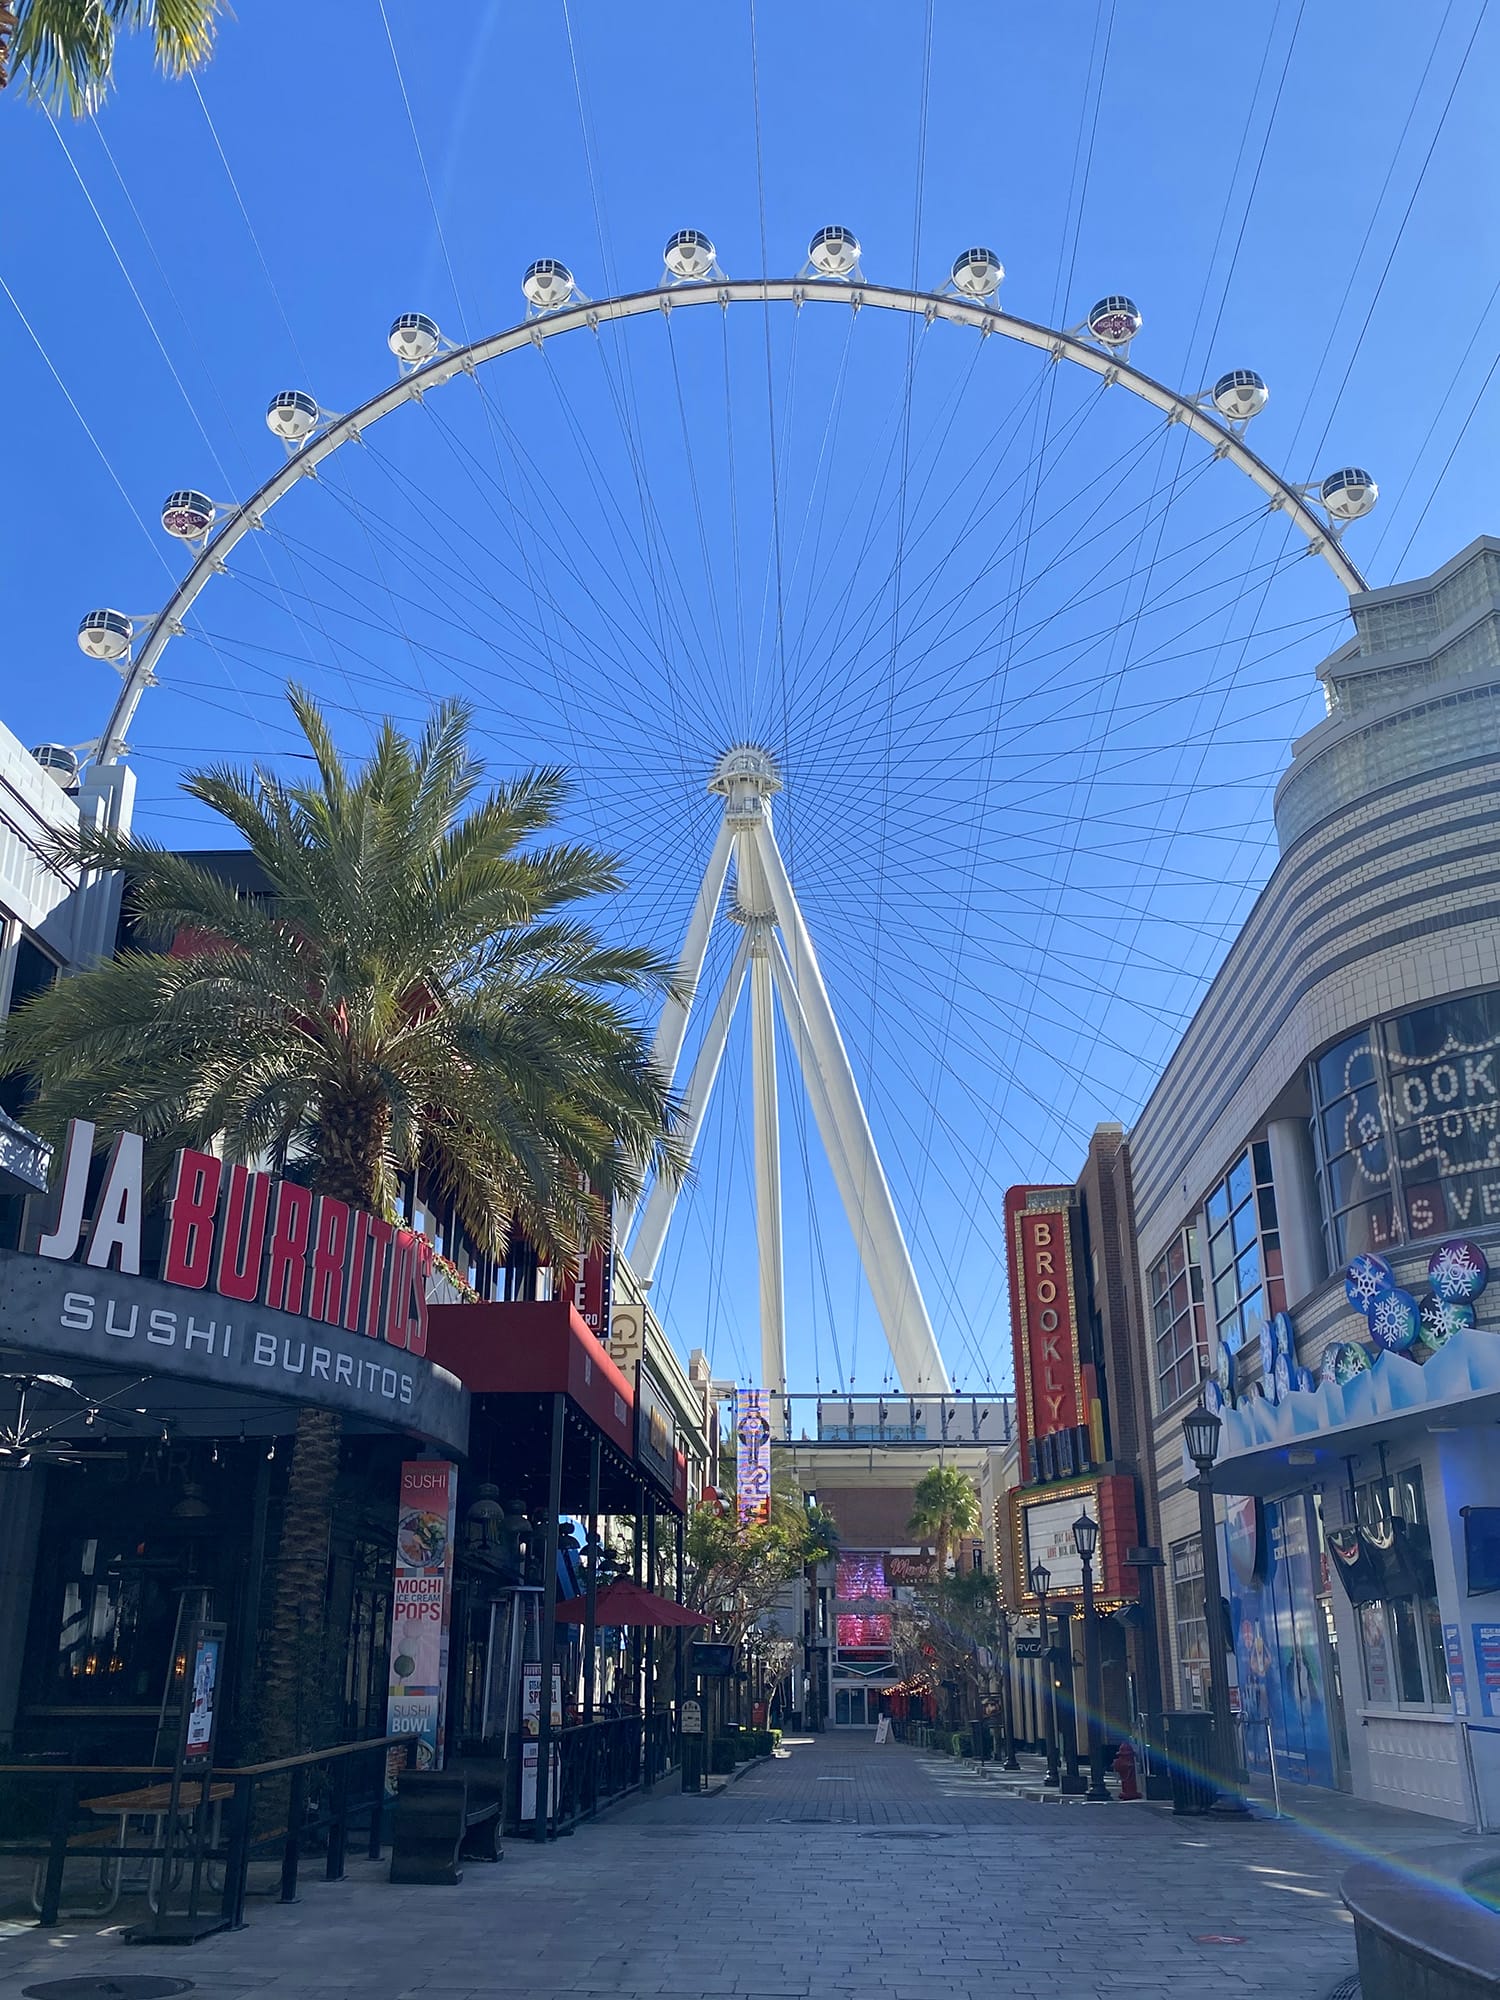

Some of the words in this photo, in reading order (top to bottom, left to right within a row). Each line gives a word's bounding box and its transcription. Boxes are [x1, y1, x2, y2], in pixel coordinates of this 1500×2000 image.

[60, 1292, 232, 1358] SUSHI
[253, 1331, 414, 1405] BURRITOS
[403, 1473, 446, 1489] SUSHI
[397, 1578, 441, 1594] MOCHI
[395, 1594, 409, 1602] ICE
[411, 1594, 441, 1602] CREAM
[395, 1602, 441, 1621] POPS
[393, 1704, 431, 1718] SUSHI
[391, 1717, 431, 1733] BOWL
